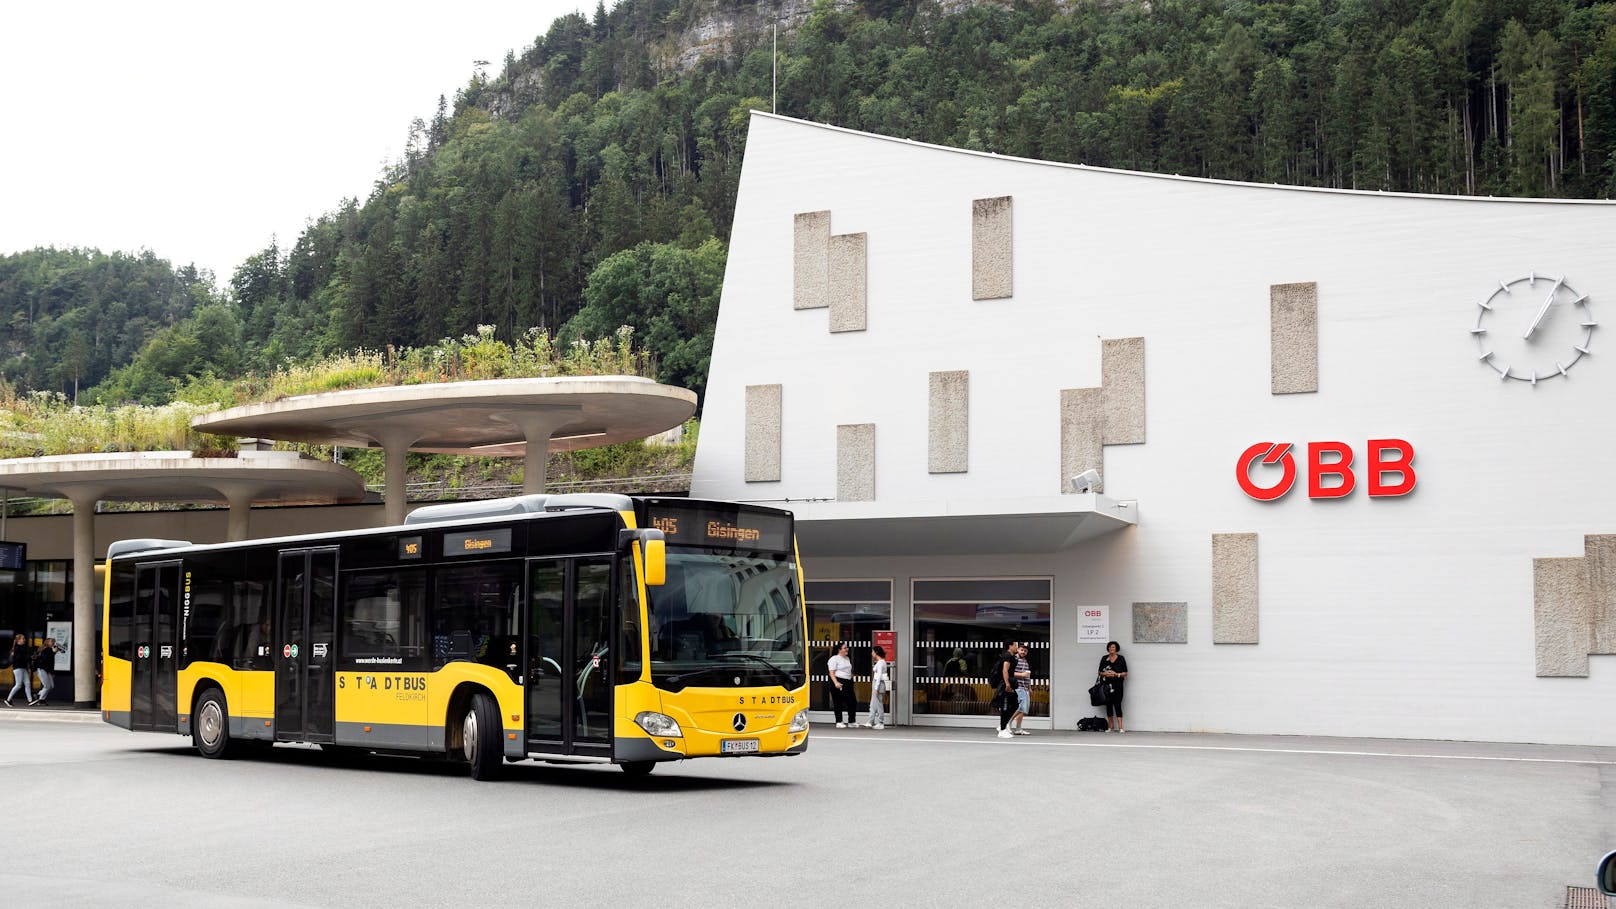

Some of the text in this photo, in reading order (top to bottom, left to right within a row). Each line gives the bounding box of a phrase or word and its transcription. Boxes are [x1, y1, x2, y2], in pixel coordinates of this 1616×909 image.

[1235, 439, 1417, 501] ÖBB
[652, 517, 760, 541] 405 Gisingen
[405, 538, 492, 554] 405 Gisingen
[396, 692, 425, 702] FELDKIRCH
